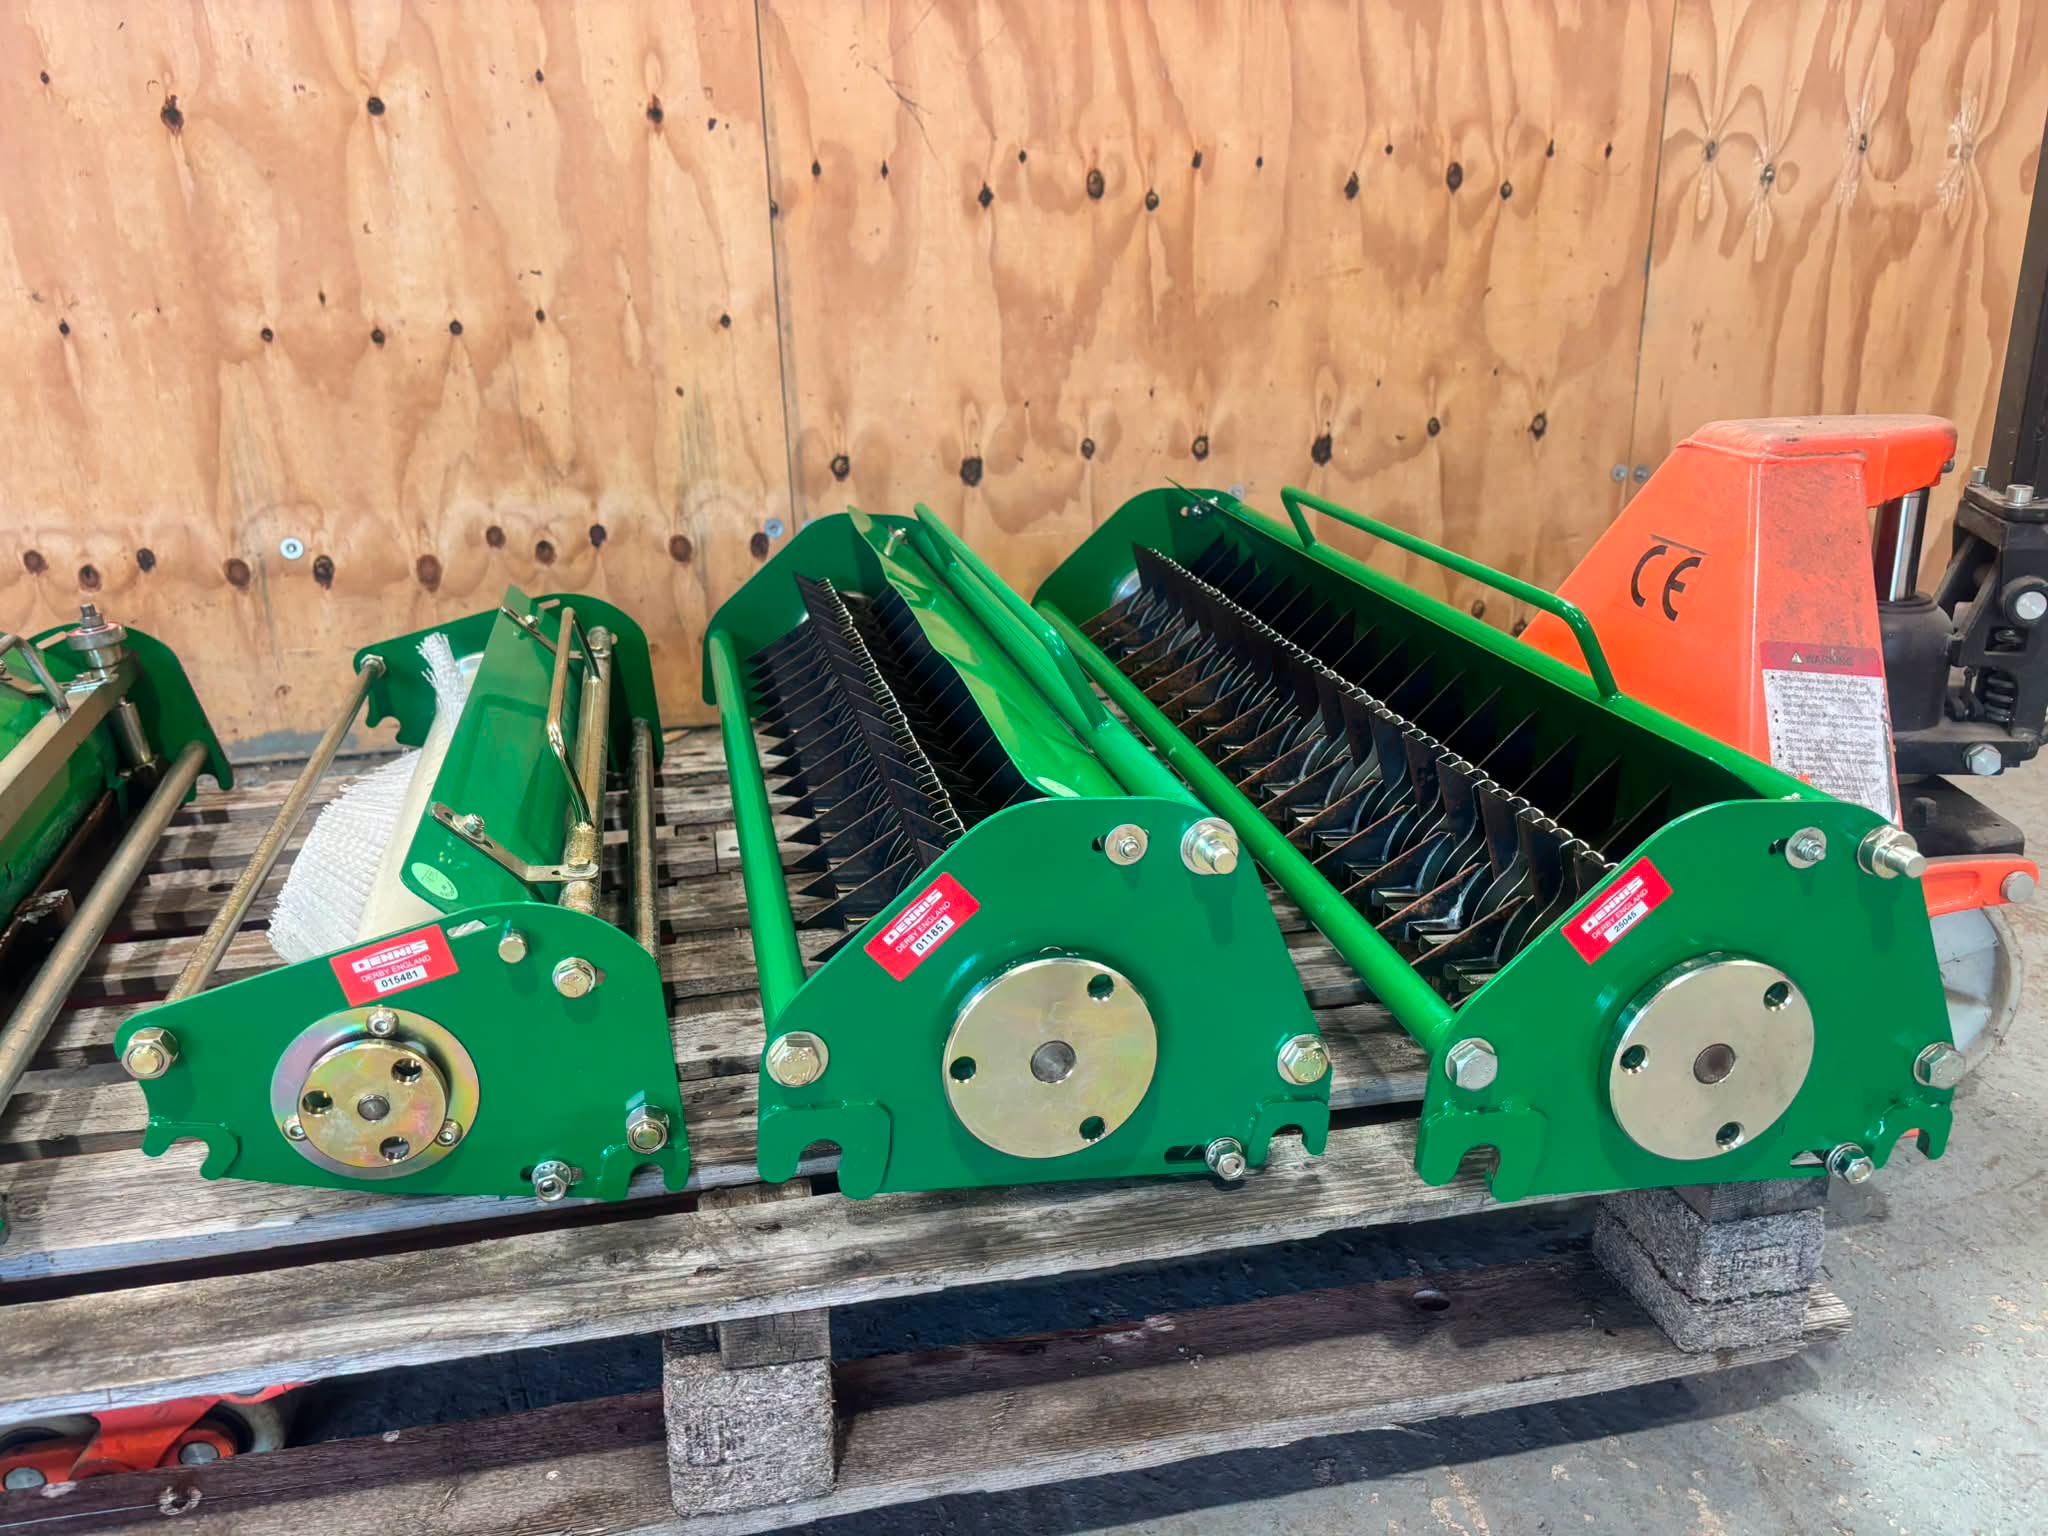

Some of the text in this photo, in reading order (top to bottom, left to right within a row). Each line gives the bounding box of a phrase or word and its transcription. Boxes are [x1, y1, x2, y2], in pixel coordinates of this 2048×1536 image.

[1804, 655, 1855, 667] WARNING
[882, 888, 943, 946] DENNIS
[1580, 875, 1644, 934] DENNIS
[1591, 888, 1648, 940] DERBY ENGLAND
[894, 900, 951, 953] DERBY ENGLAND
[915, 919, 949, 951] 011851
[1614, 911, 1637, 933] 25045
[351, 939, 429, 974] DENNIS
[360, 954, 431, 983] DERBY ENGLAND
[381, 970, 419, 988] 015481
